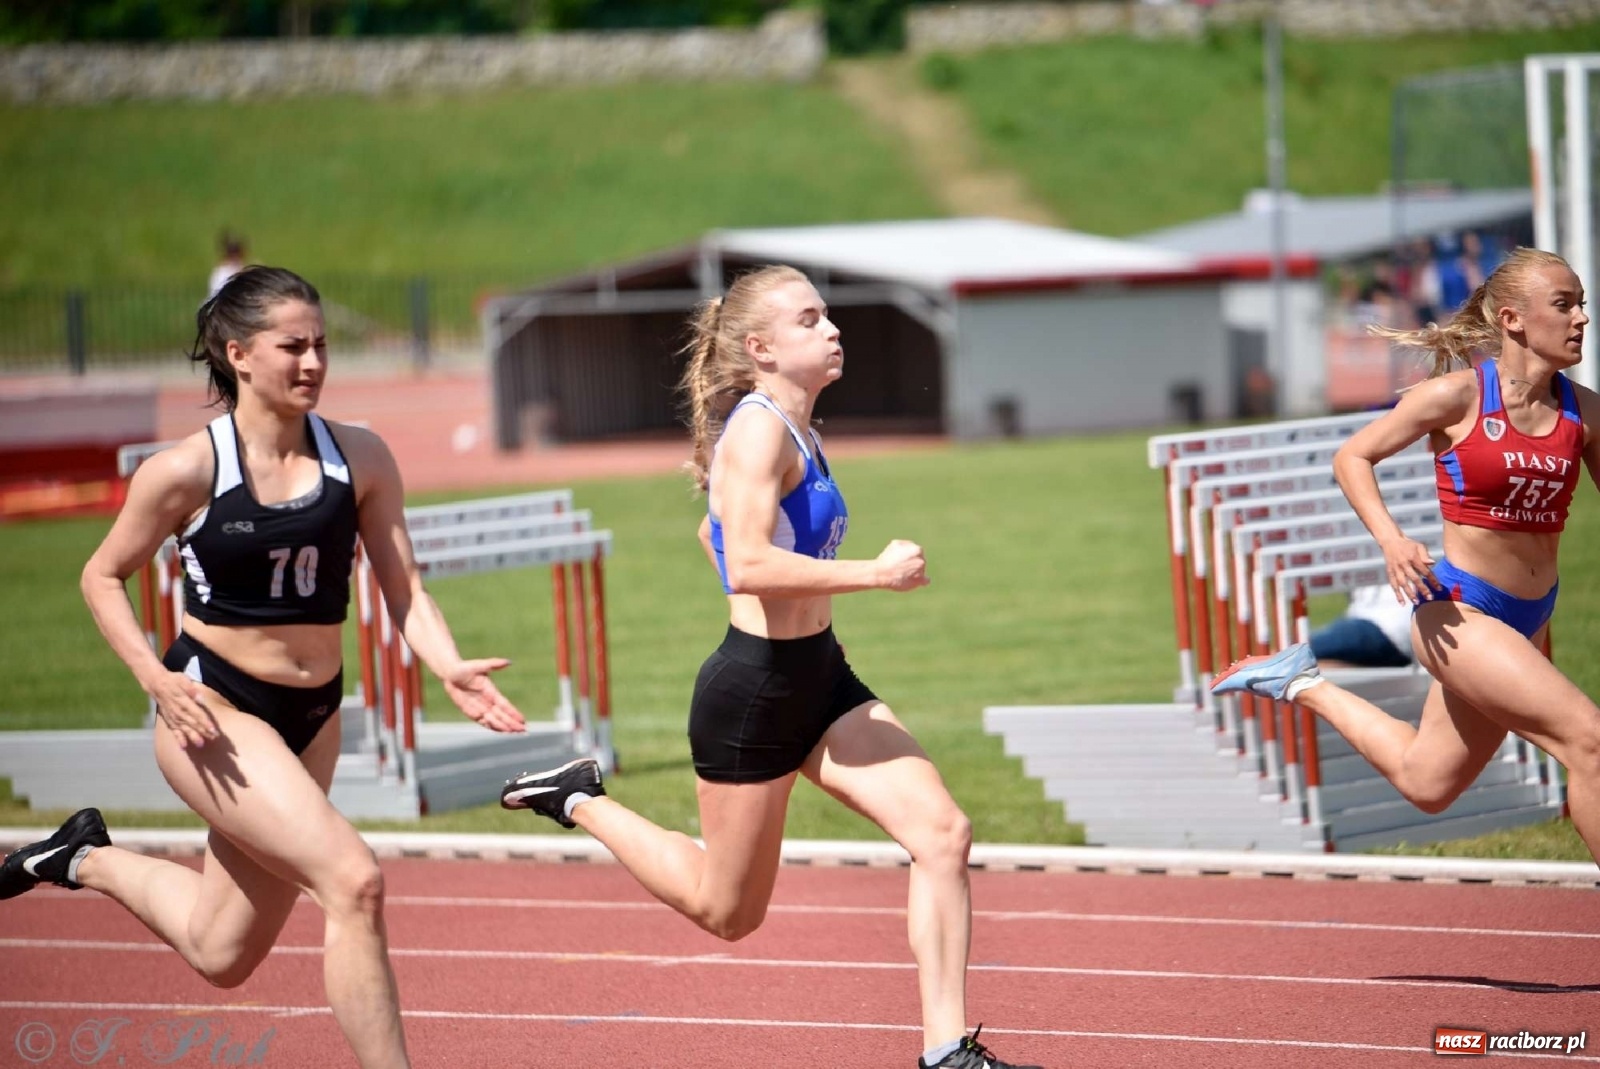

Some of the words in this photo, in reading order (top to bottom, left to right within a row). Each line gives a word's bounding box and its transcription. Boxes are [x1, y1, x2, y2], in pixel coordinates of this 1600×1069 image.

[1502, 452, 1571, 476] PIAST
[1503, 476, 1564, 508] 757
[1490, 506, 1559, 523] GLIWICE
[222, 521, 255, 534] esa
[269, 545, 319, 598] 70
